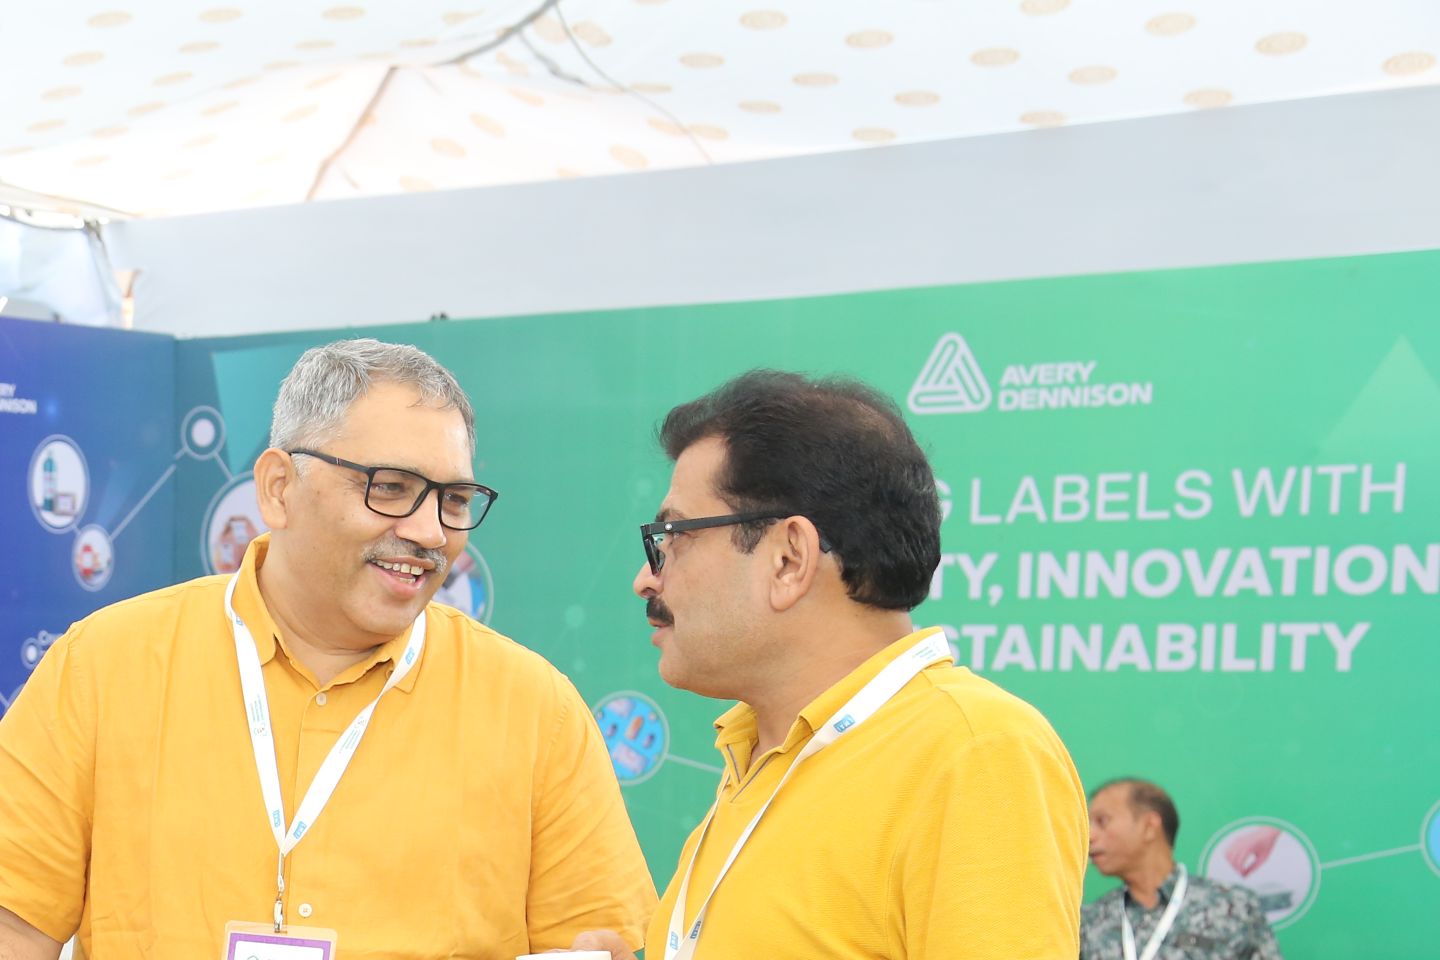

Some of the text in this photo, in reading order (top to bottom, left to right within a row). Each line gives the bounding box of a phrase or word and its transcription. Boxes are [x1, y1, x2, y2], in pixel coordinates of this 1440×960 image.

[1000, 360, 1097, 386] AVERY
[998, 382, 1153, 411] DENNISON
[970, 469, 1214, 524] LABELS
[1231, 462, 1406, 518] WITH
[1017, 543, 1440, 600] INNOVATION
